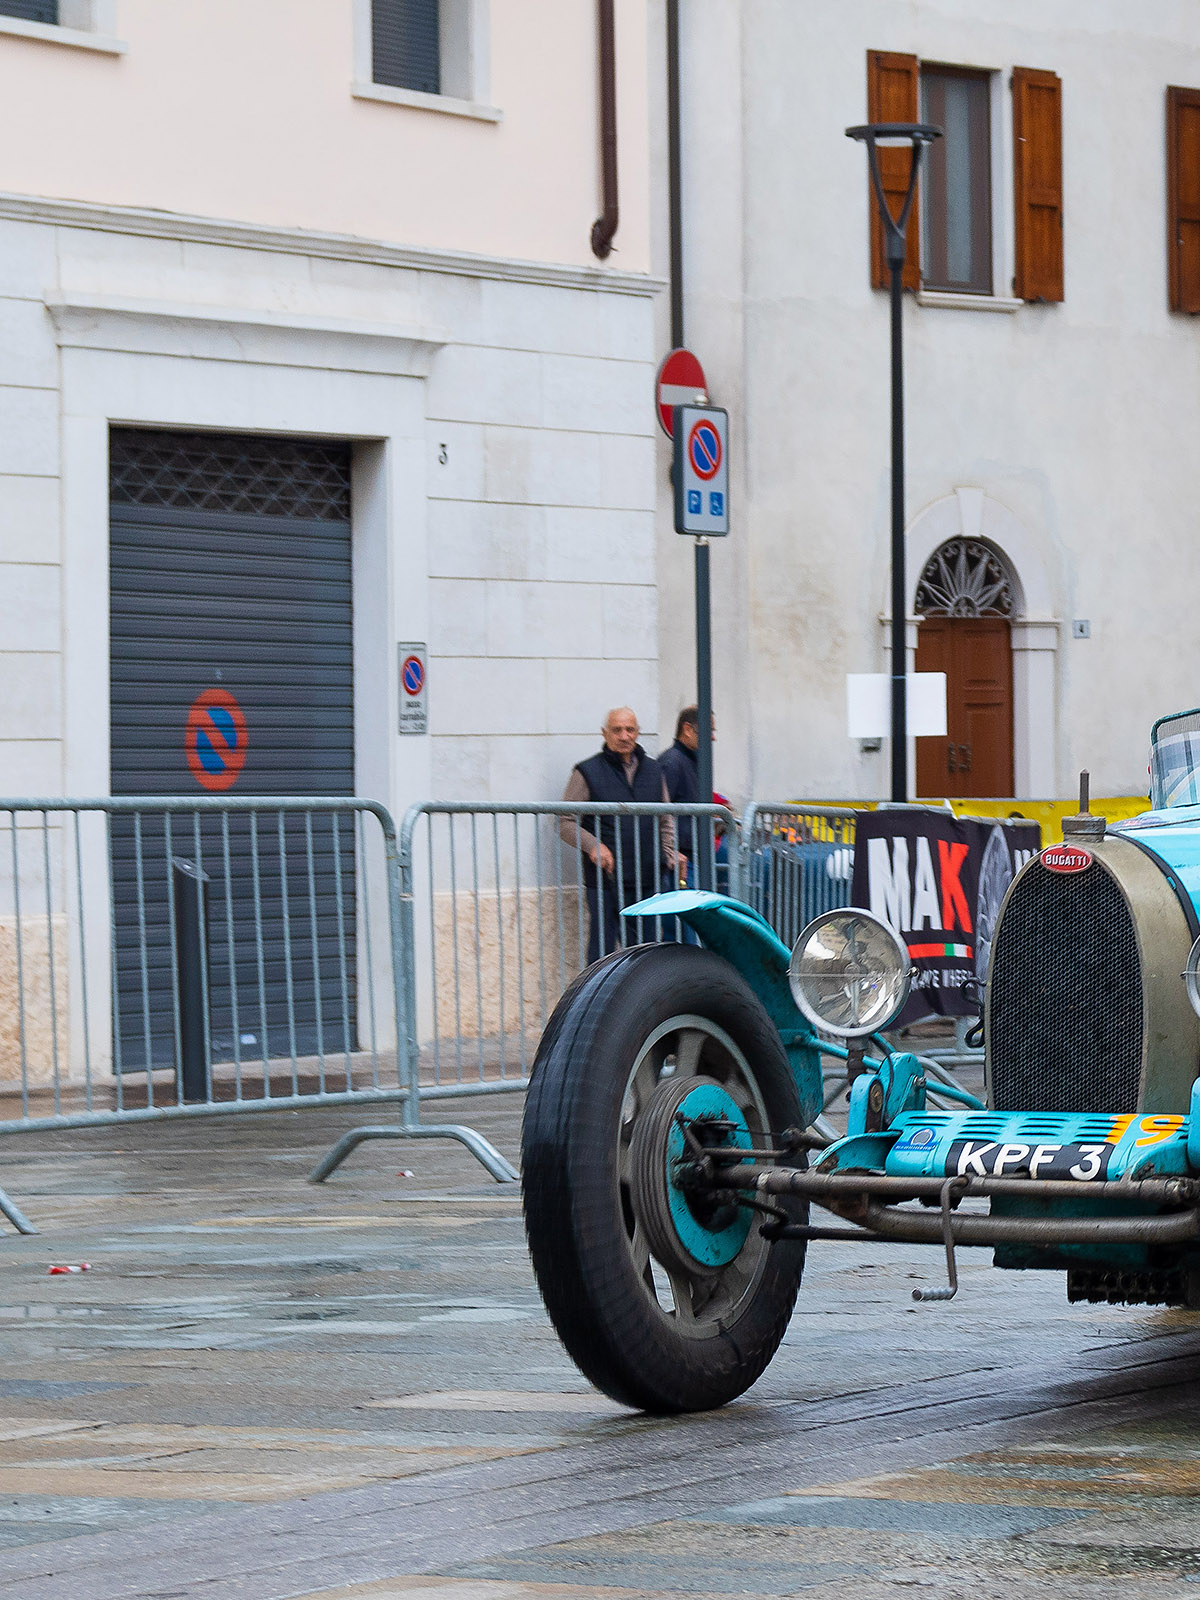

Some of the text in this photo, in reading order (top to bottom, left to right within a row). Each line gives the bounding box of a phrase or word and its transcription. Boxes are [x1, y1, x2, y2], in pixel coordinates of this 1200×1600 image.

[1045, 854, 1087, 867] BUGATTI
[867, 836, 974, 933] MAK
[1105, 1114, 1185, 1147] 19
[956, 1141, 1103, 1181] KPF 3
